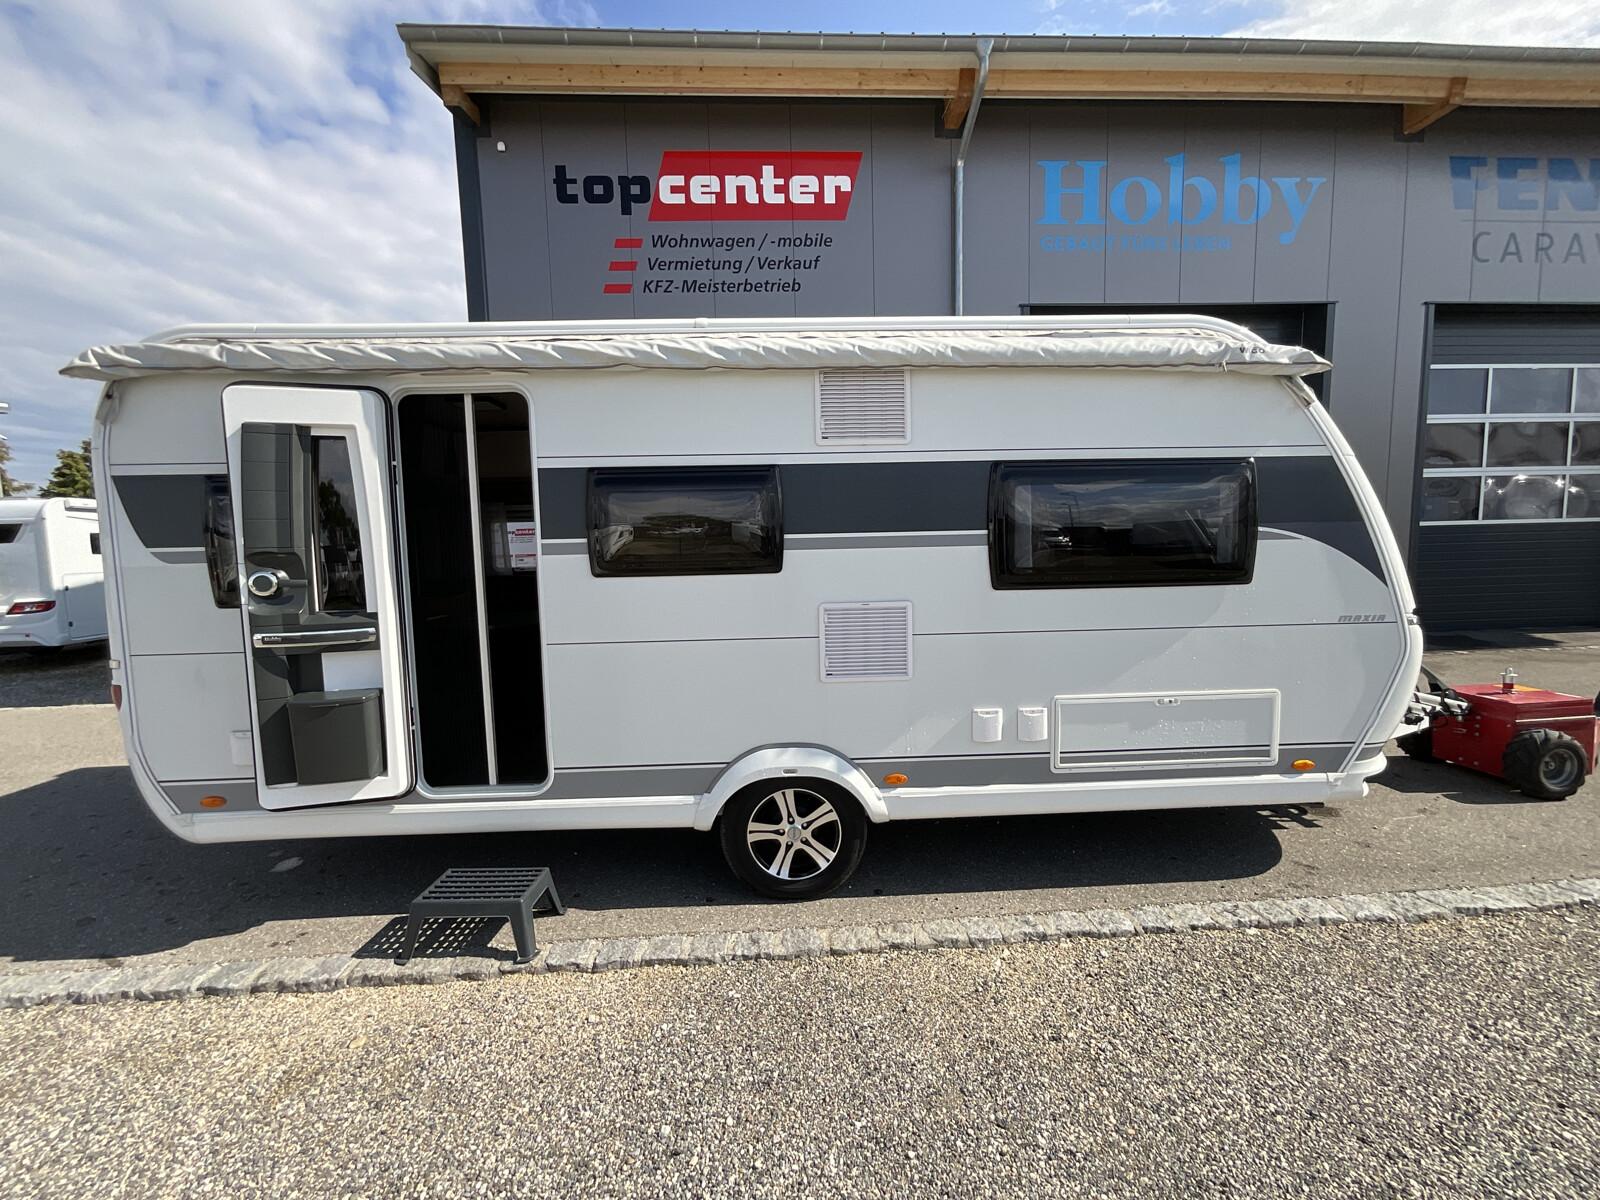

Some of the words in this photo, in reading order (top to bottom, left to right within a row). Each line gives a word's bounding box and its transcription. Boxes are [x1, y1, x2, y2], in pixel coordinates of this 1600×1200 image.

[1034, 152, 1327, 245] Hobby
[642, 278, 801, 294] KFZ-Meisterbetrieb
[1239, 346, 1266, 354] WGO
